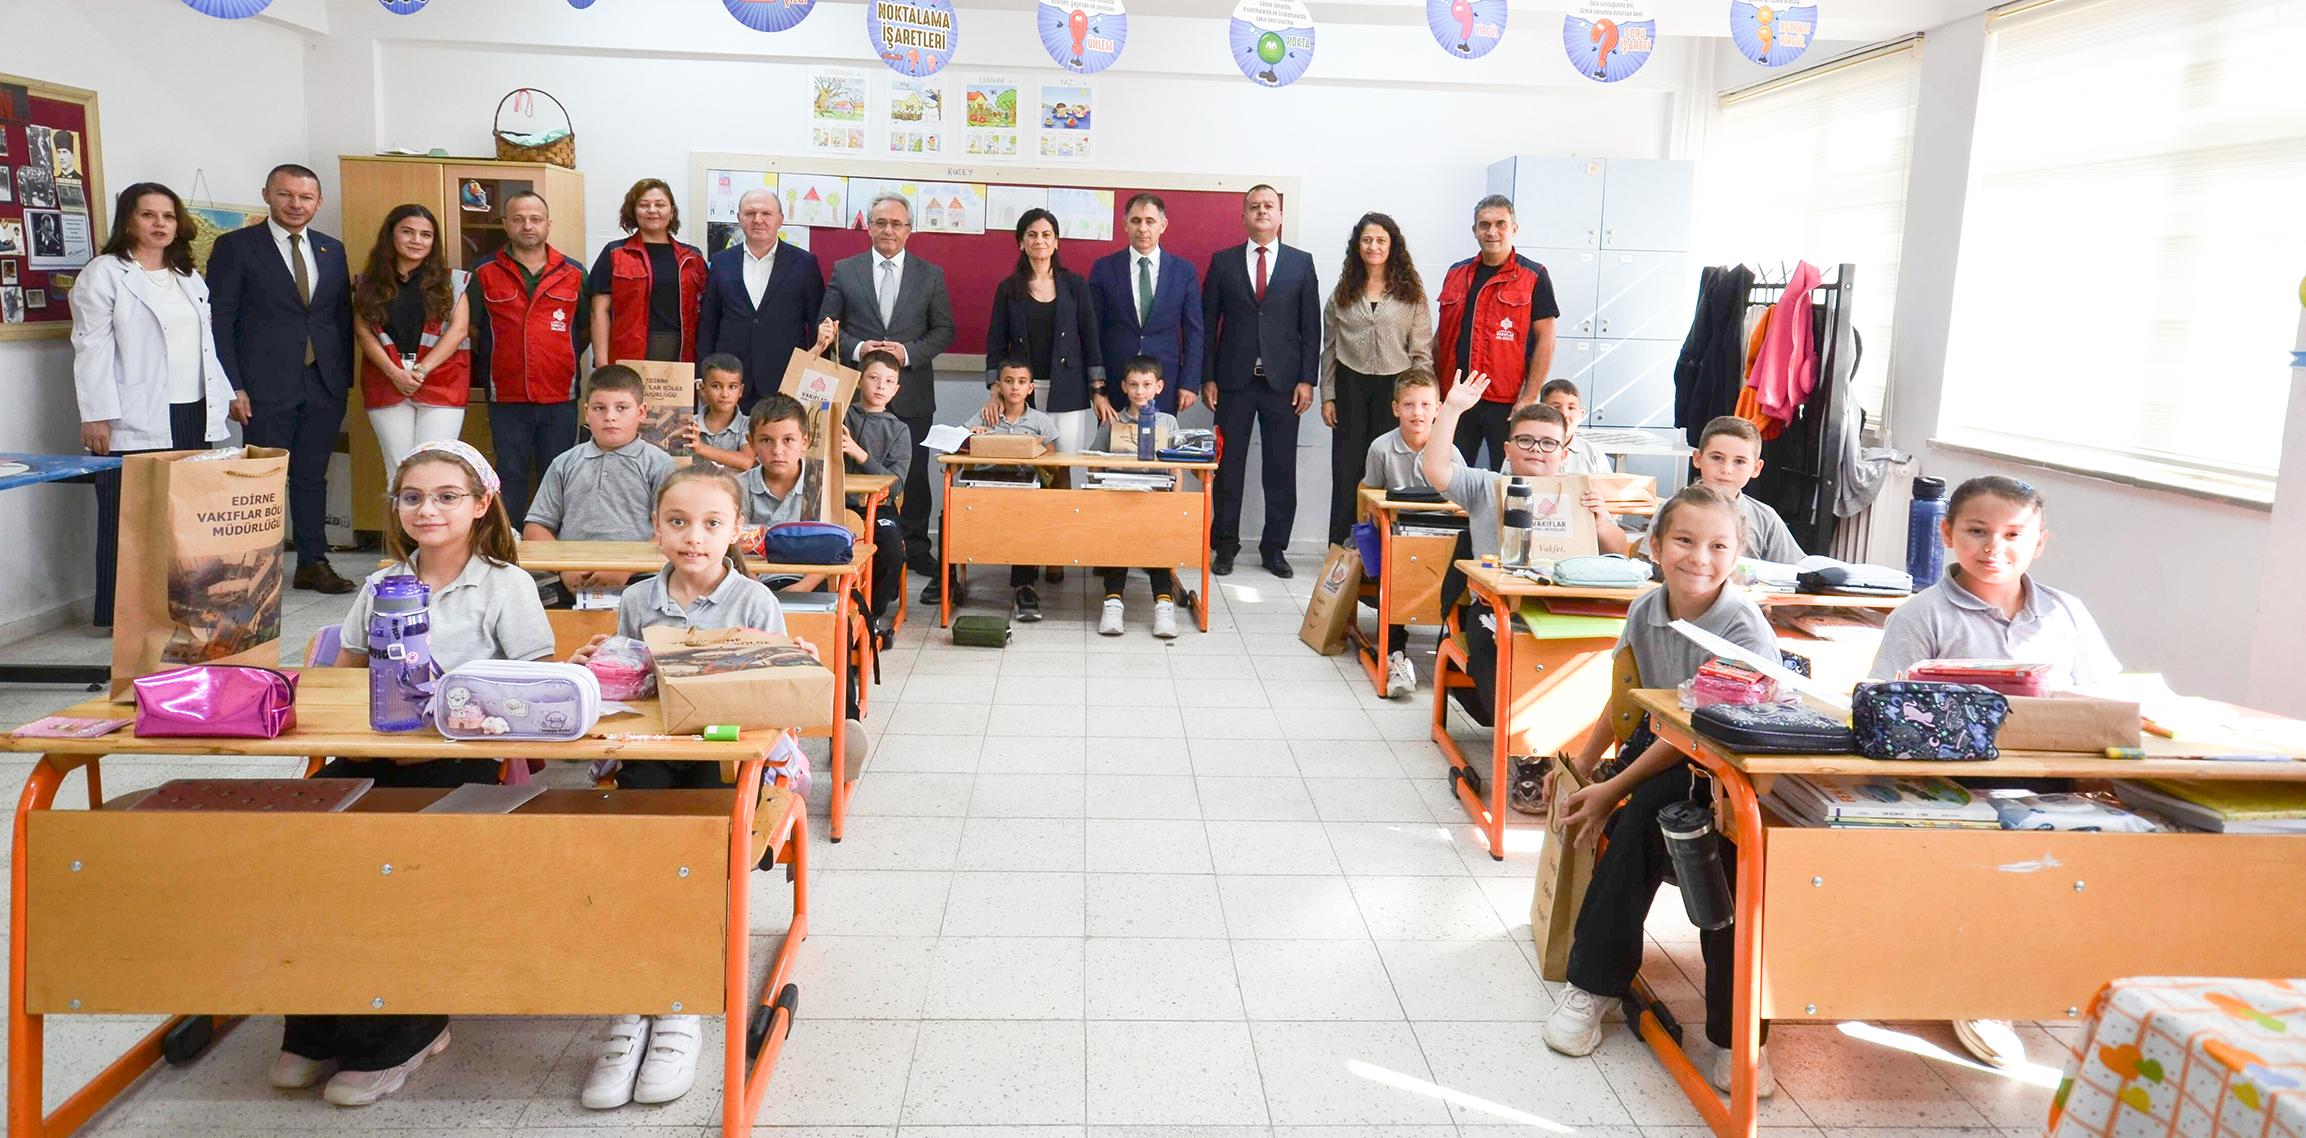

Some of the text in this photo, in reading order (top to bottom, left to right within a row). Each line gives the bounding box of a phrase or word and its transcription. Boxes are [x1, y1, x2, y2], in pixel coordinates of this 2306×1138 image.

[878, 5, 950, 29] NOKTALAMA
[883, 25, 946, 50] İŞARETLERİ
[1287, 36, 1310, 48] NOKTA
[1624, 27, 1647, 39] SORU
[1088, 35, 1114, 52] ÜNLEM
[232, 492, 275, 506] EDİRNE
[197, 503, 282, 523] VAKIFLAR BÖL
[212, 517, 282, 537] MÜDÜRLÜĞÜ
